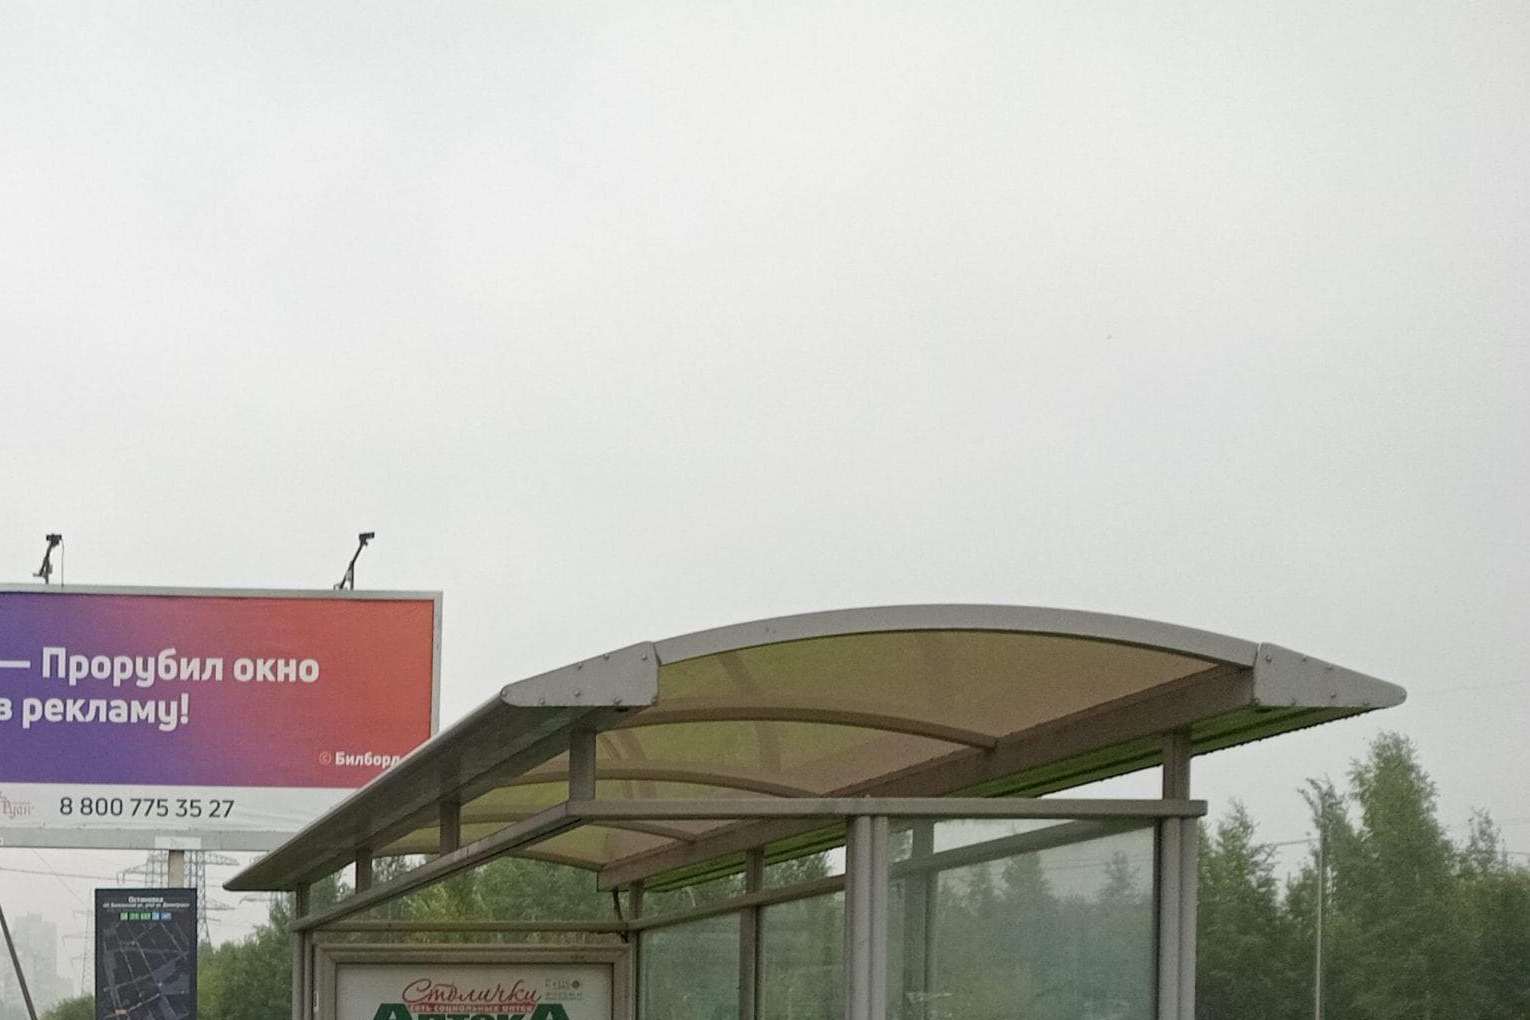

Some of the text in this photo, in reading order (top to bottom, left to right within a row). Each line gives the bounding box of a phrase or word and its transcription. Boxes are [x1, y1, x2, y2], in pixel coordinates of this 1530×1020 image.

[42, 647, 223, 688] Прорубил
[233, 658, 319, 682] окно
[23, 693, 189, 731] рекламу!
[60, 797, 235, 818] 8 800 775 35 27
[402, 978, 541, 1003] Столички
